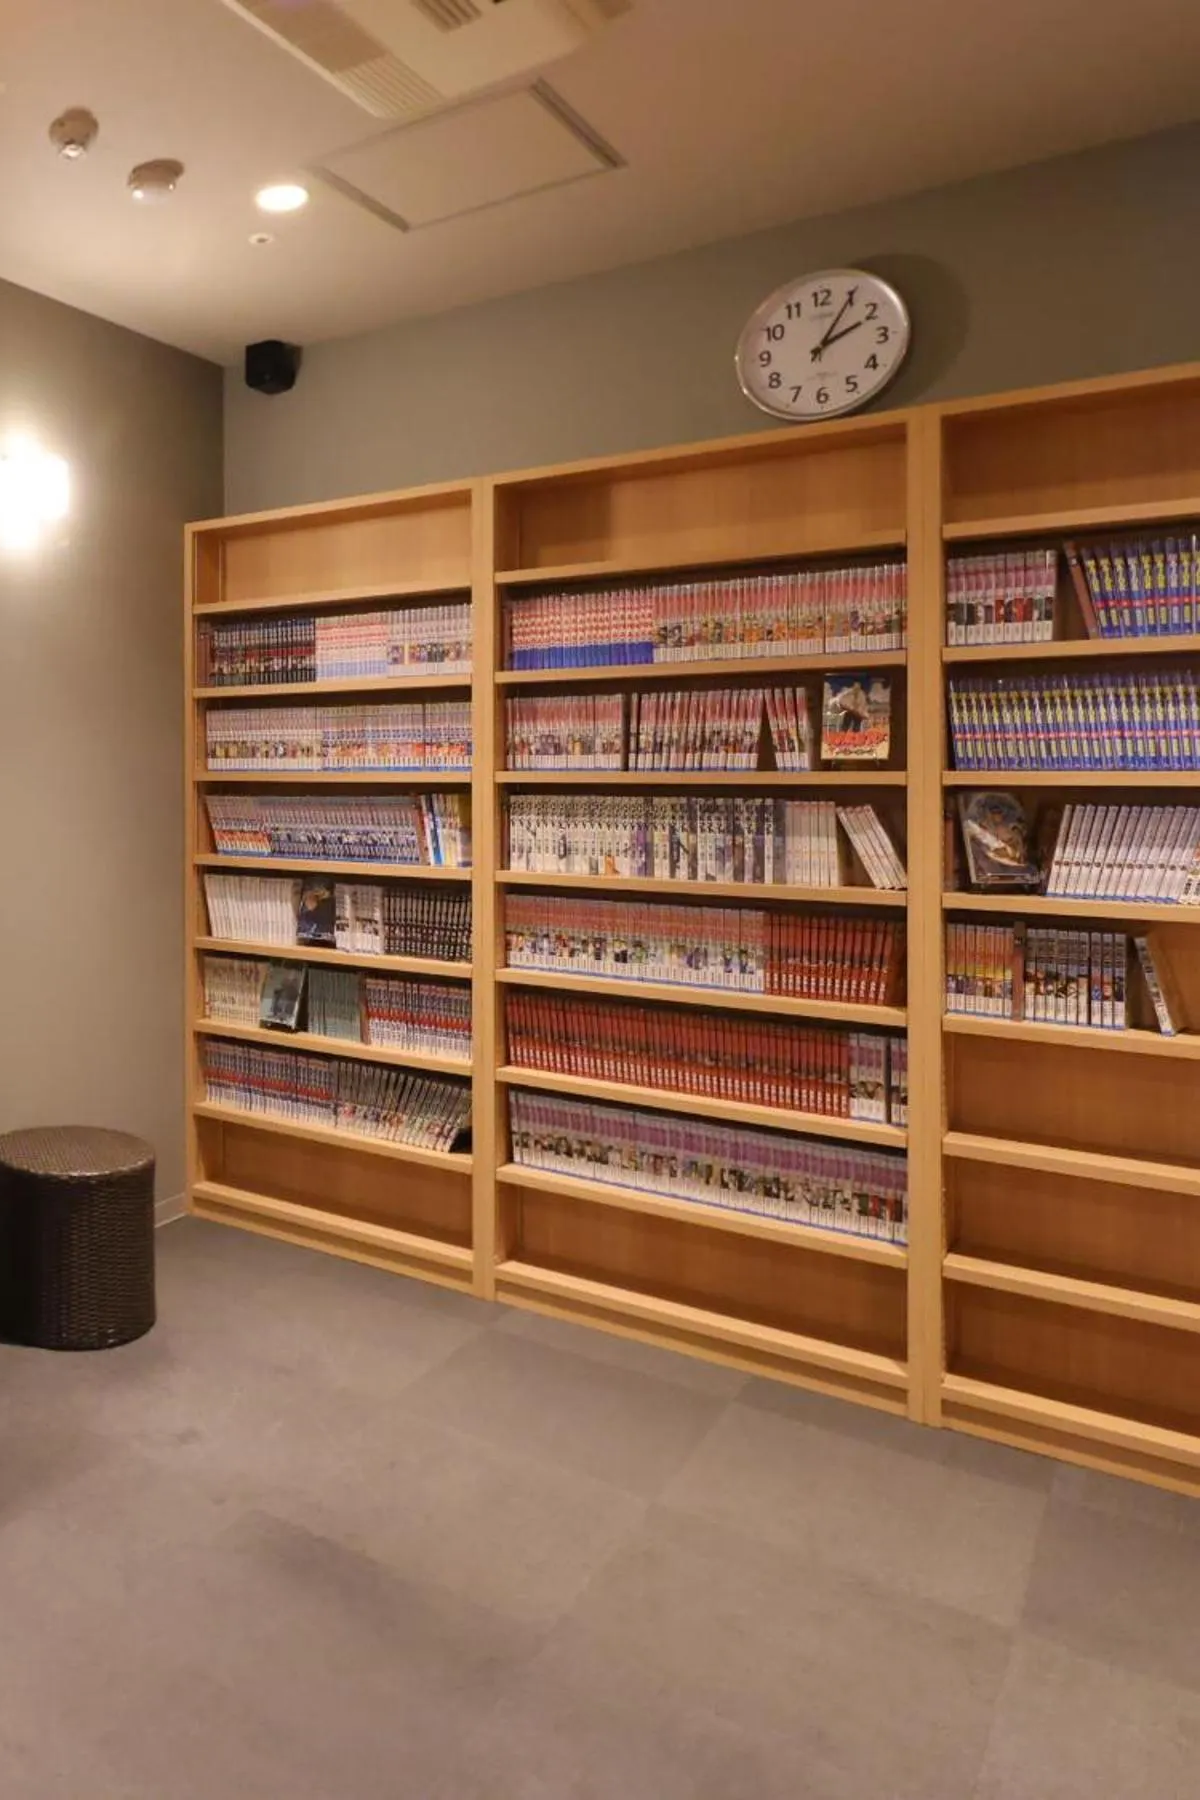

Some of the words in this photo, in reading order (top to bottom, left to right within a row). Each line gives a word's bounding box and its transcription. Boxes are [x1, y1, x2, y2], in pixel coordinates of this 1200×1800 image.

[811, 288, 832, 308] 12
[785, 302, 802, 320] 11
[864, 303, 878, 321] 2
[766, 323, 785, 342] 10
[875, 325, 889, 344] 3
[759, 350, 772, 367] 9
[864, 353, 879, 370] 4
[768, 371, 782, 389] 8
[845, 375, 858, 393] 5
[789, 386, 802, 403] 7
[816, 387, 829, 404] 6
